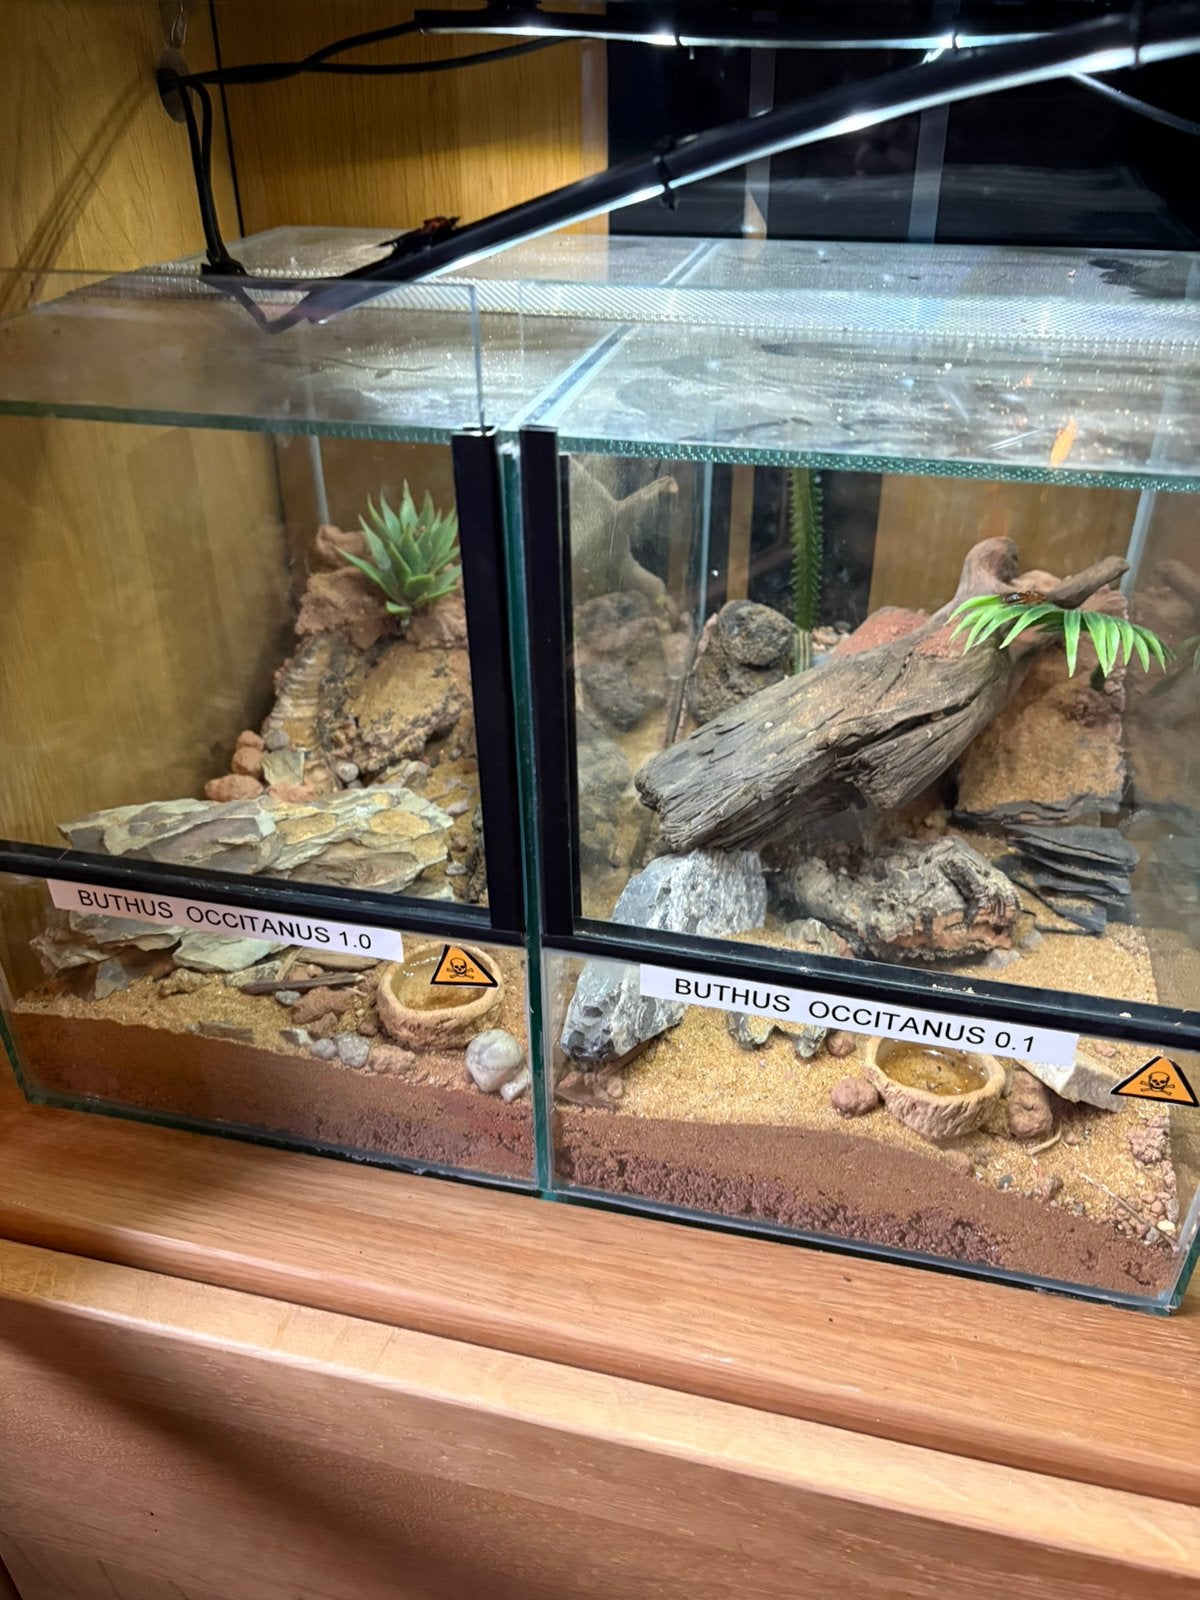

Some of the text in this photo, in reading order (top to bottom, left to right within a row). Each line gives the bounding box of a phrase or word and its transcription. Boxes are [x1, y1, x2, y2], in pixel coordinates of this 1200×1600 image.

[77, 889, 372, 950] BUTHUS OCCITANUS 1.0
[674, 978, 1035, 1053] BUTHUS OCCITANUS 0.1
